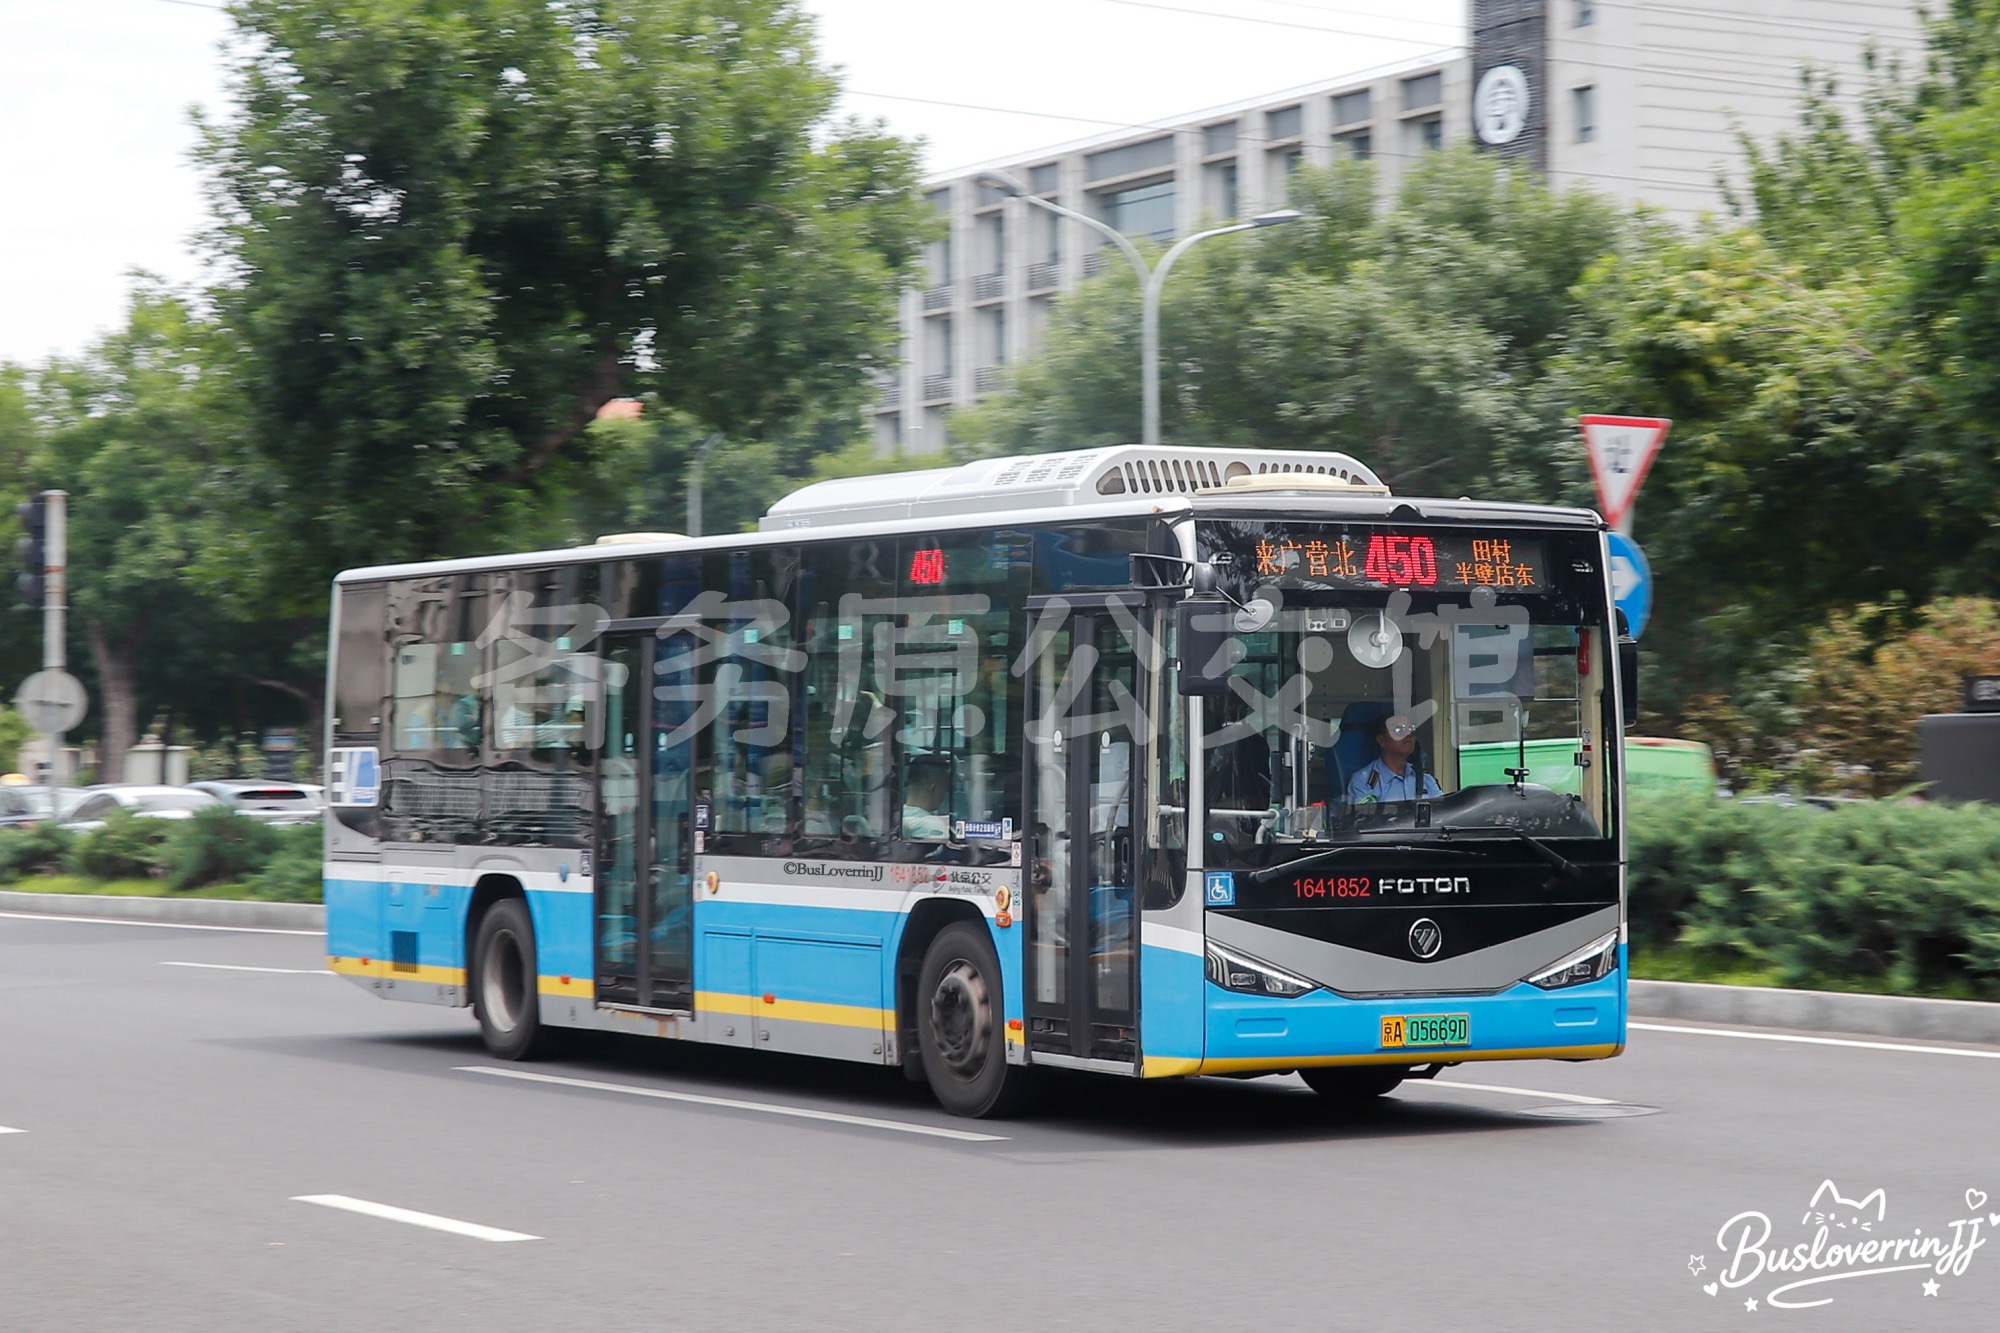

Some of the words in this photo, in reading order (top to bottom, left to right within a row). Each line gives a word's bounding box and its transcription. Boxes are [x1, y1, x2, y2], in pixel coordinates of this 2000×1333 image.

[1255, 539, 1358, 577] 来广营北
[1365, 535, 1438, 585] 450
[1472, 539, 1511, 564] 田村
[1455, 562, 1536, 587] 半壁店东
[950, 871, 992, 885] 北京公交
[1293, 877, 1371, 898] 1641852
[1378, 877, 1470, 895] FOTON
